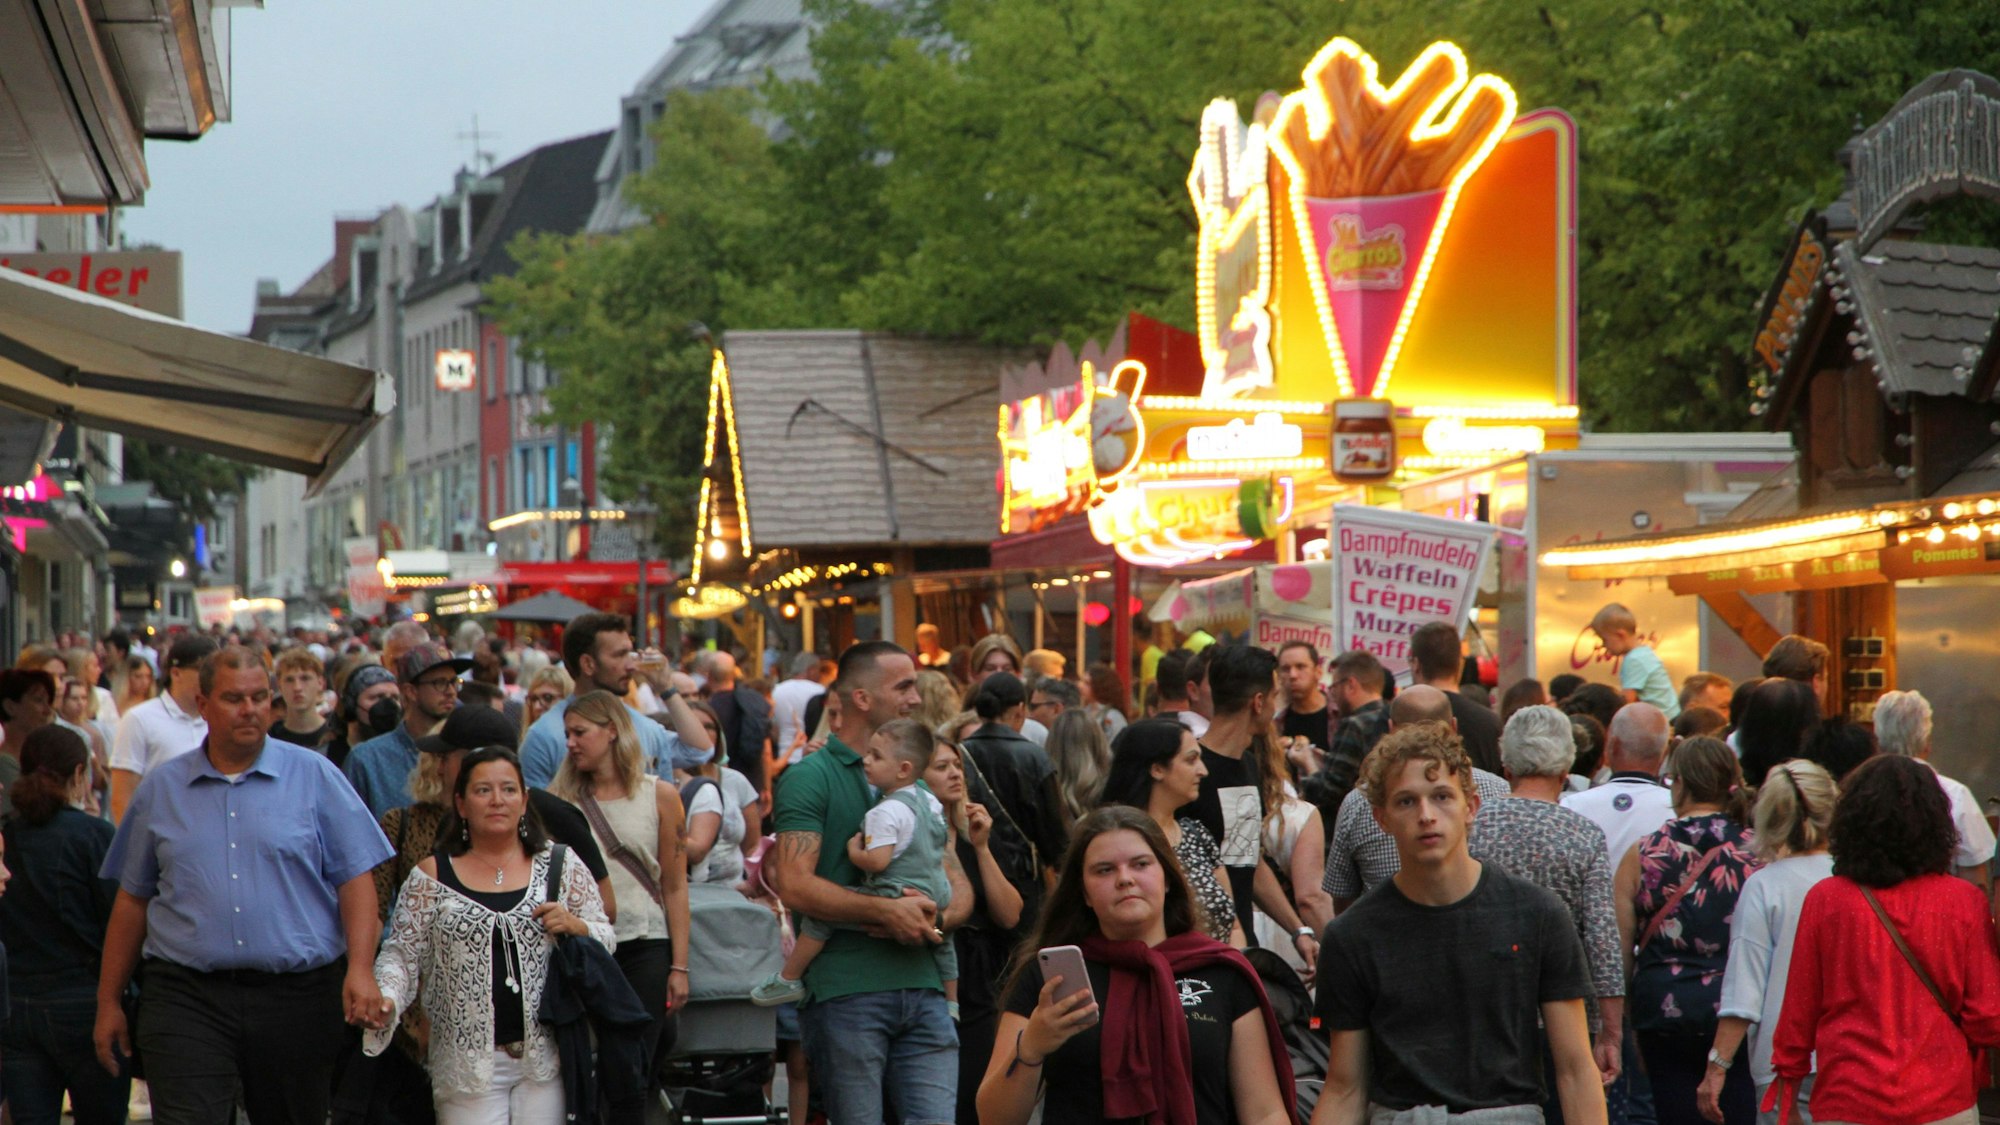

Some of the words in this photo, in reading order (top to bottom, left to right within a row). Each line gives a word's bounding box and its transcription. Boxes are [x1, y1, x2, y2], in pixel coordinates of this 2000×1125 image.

[0, 254, 150, 297] eler
[447, 363, 464, 377] M
[1340, 527, 1478, 571] Dampfnudeln
[1912, 547, 1979, 564] Pommes
[1353, 556, 1457, 589] Waffeln
[1349, 580, 1453, 616] Crêpes
